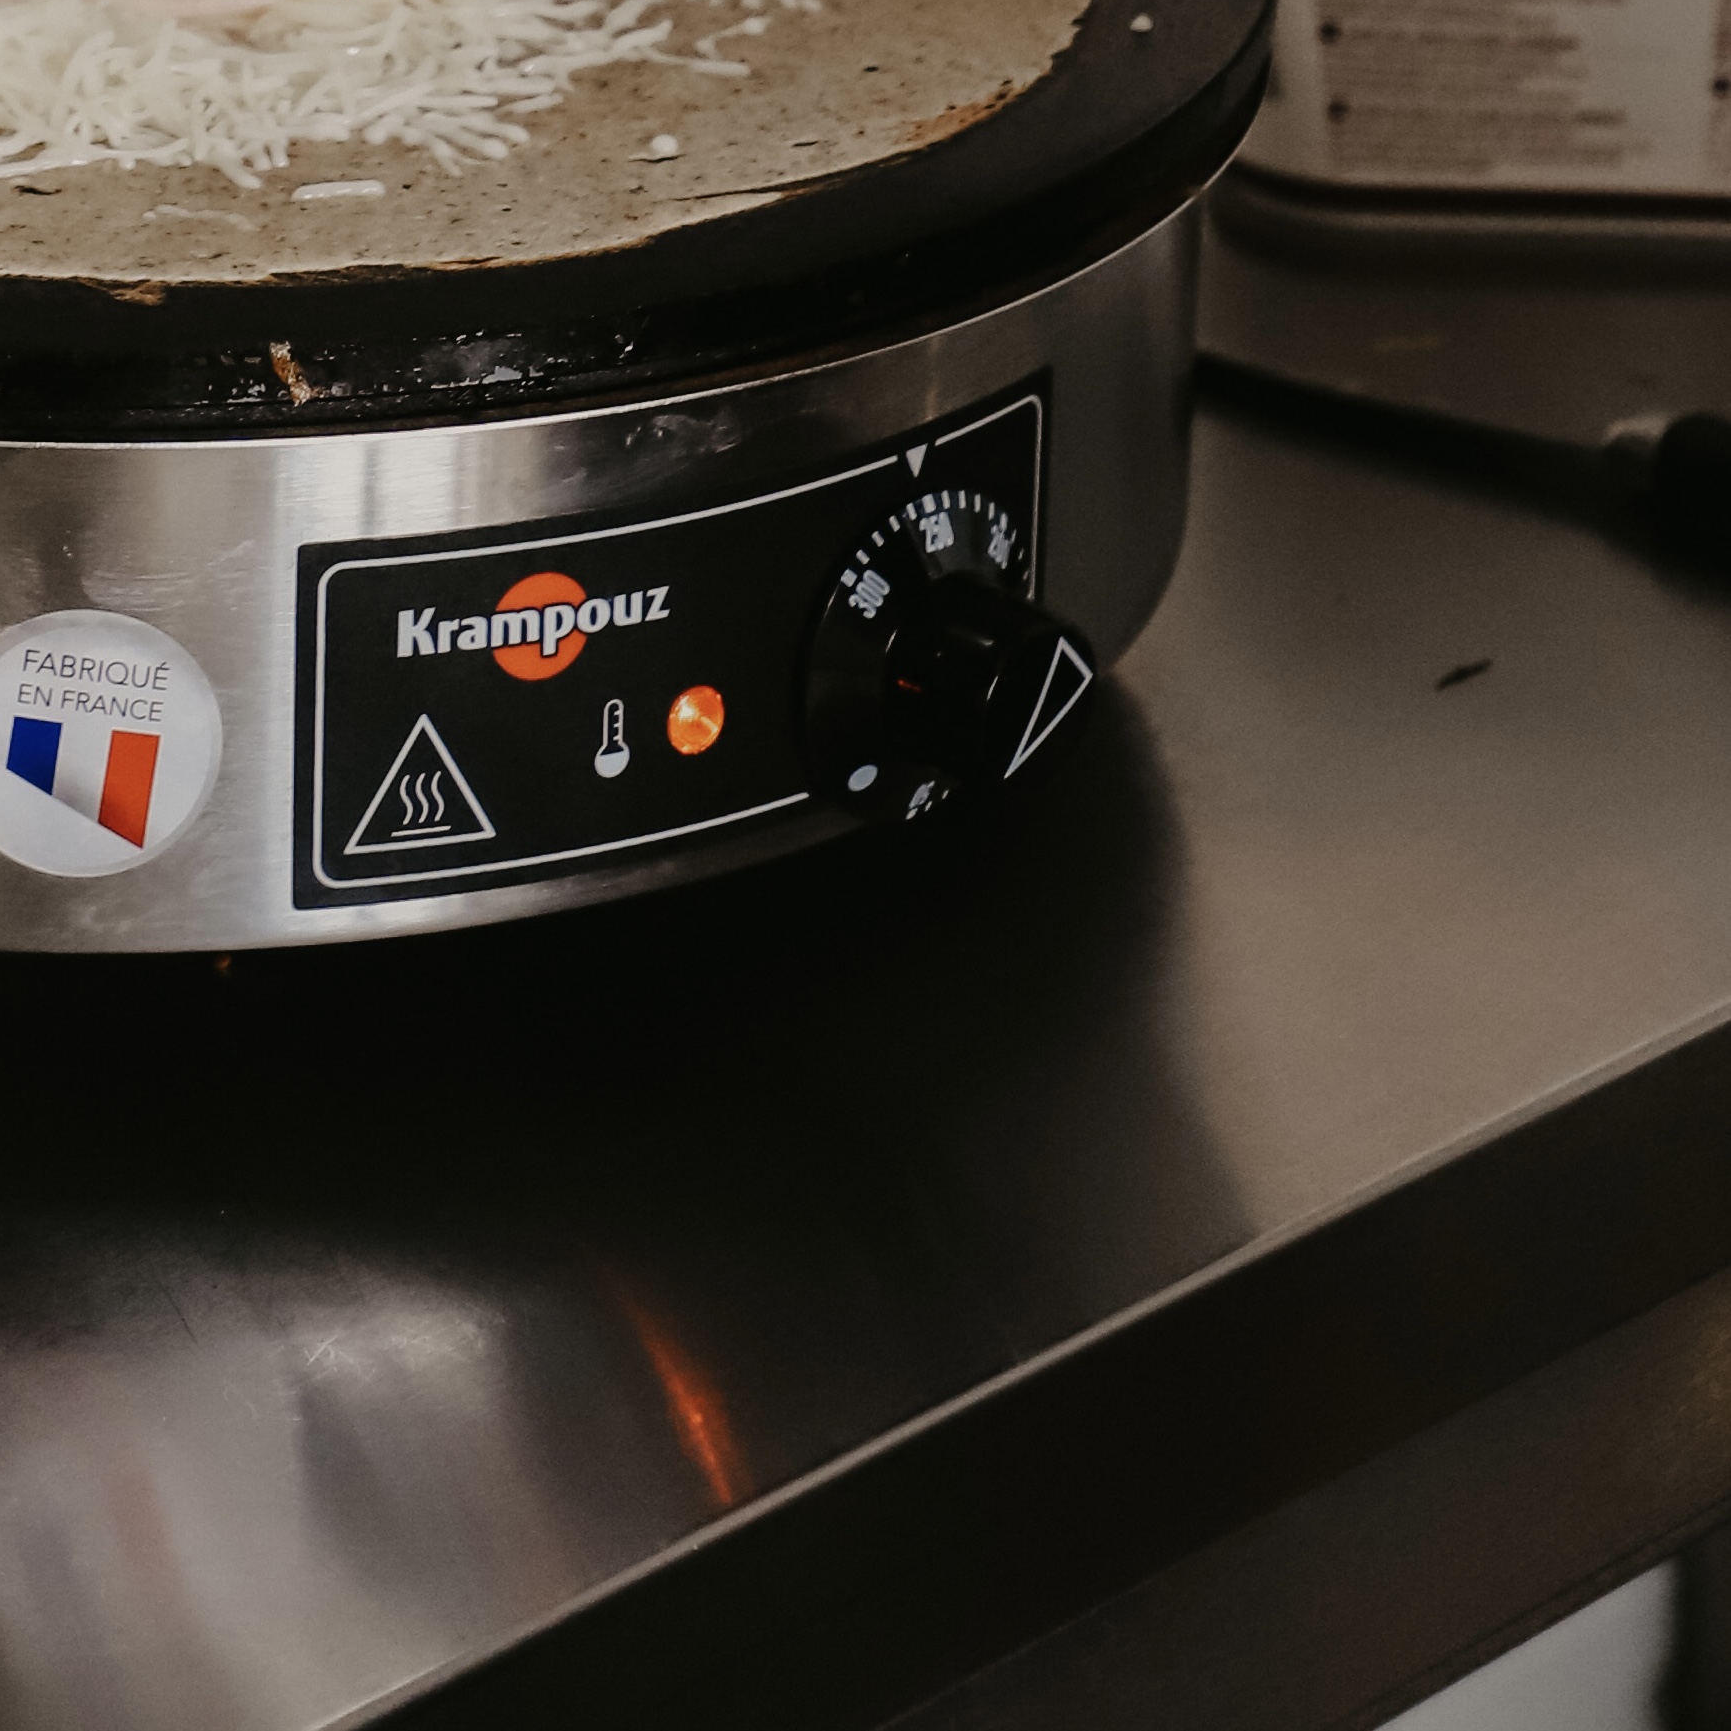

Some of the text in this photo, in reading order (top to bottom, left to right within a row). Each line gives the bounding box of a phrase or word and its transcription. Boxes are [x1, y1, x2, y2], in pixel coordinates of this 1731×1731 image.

[848, 569, 891, 619] 300
[396, 585, 671, 658] Krampouz
[22, 648, 171, 691] FABRIQUÉ
[16, 682, 165, 723] EN FRANCE
